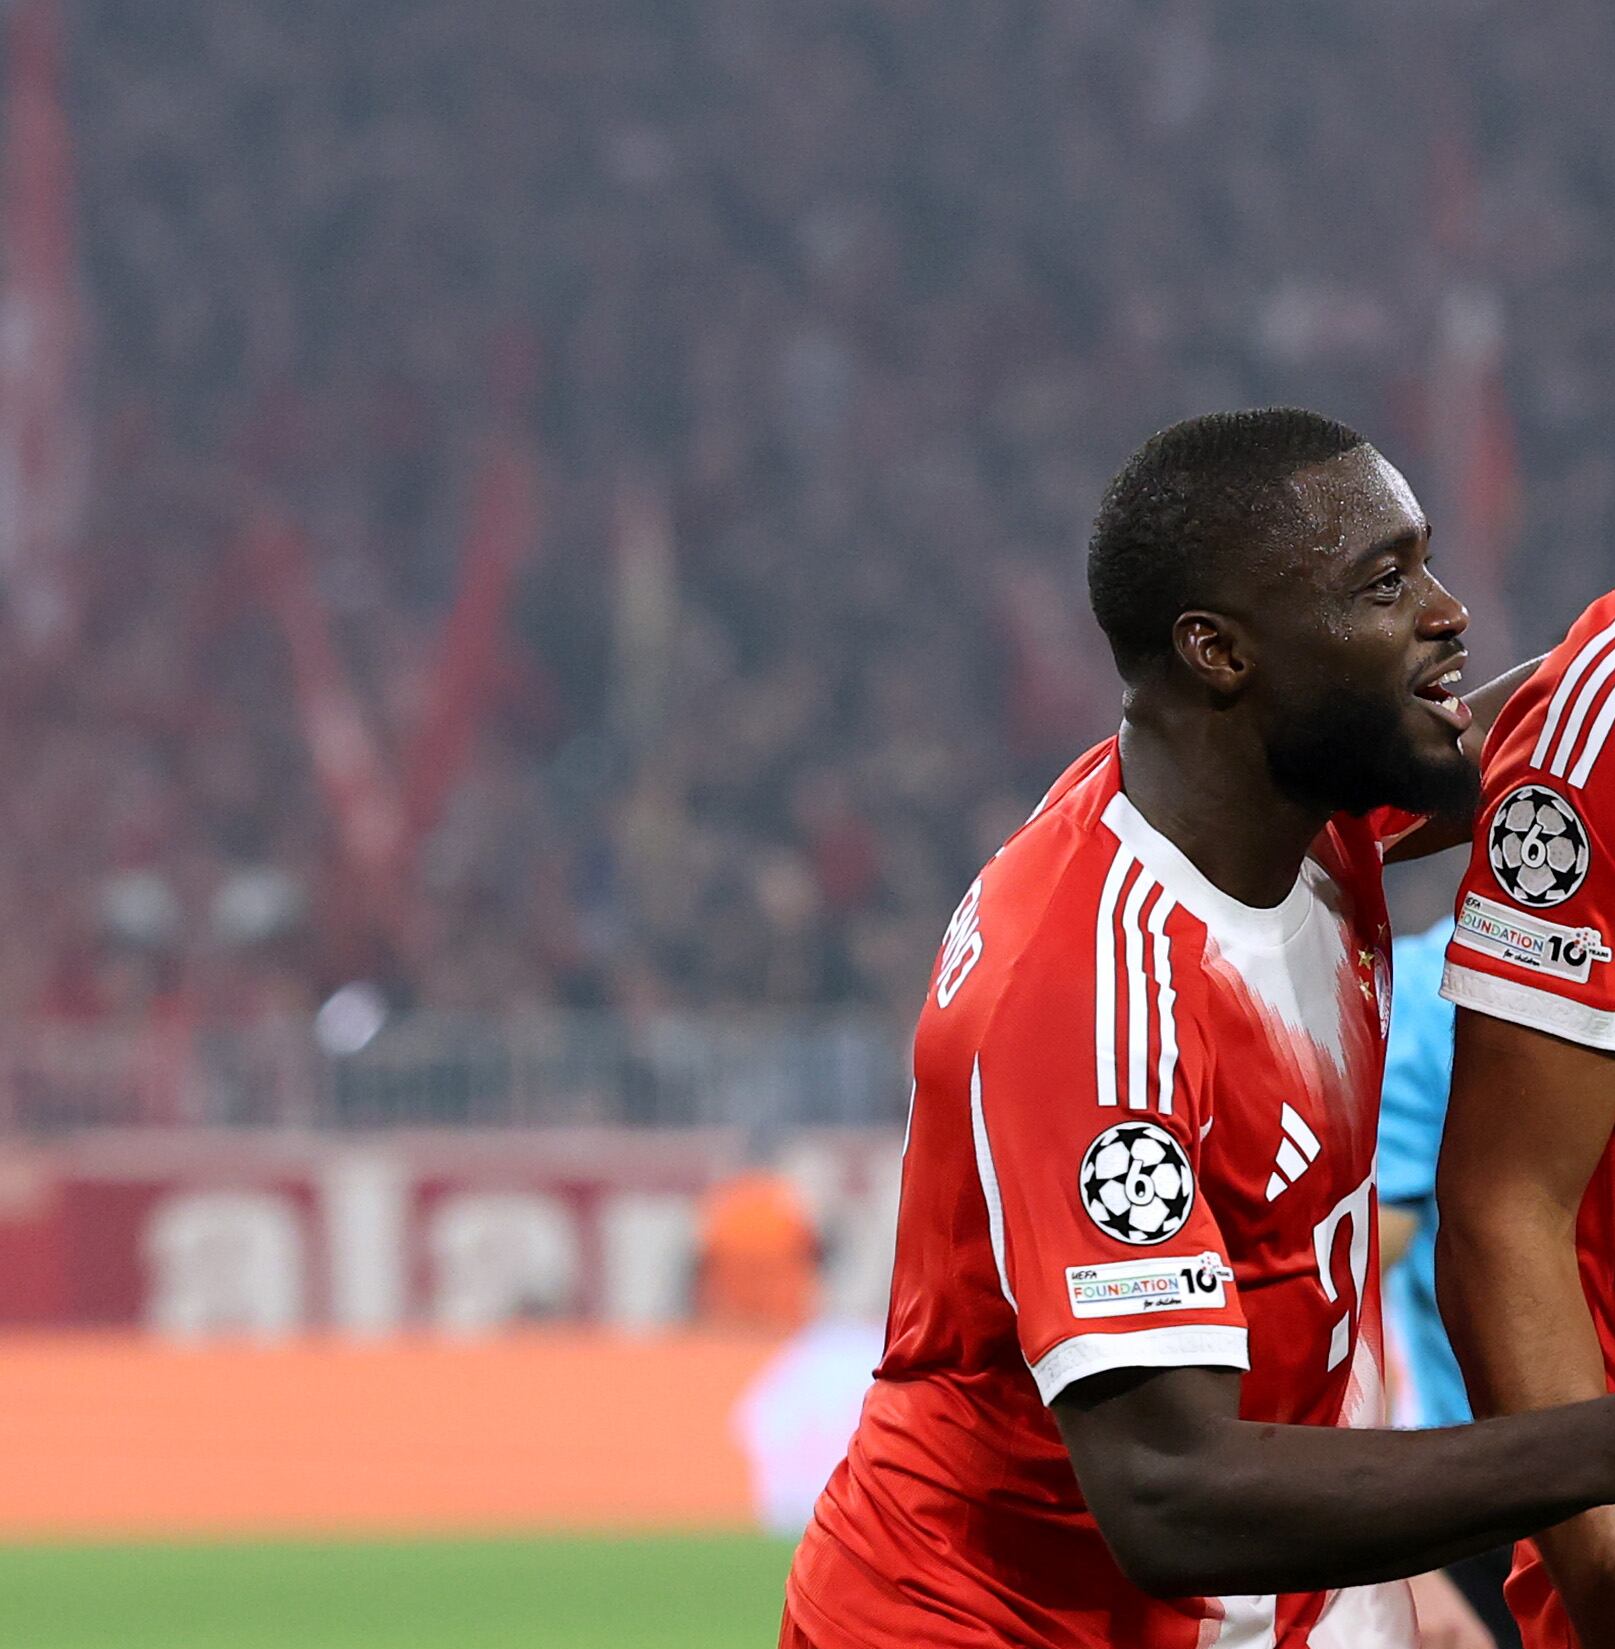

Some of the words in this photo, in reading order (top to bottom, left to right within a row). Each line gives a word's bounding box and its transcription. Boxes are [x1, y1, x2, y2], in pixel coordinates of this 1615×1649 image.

[1520, 823, 1546, 869] 6
[1548, 935, 1587, 967] 10
[1124, 1159, 1156, 1206] 6
[1180, 1268, 1217, 1294] 10
